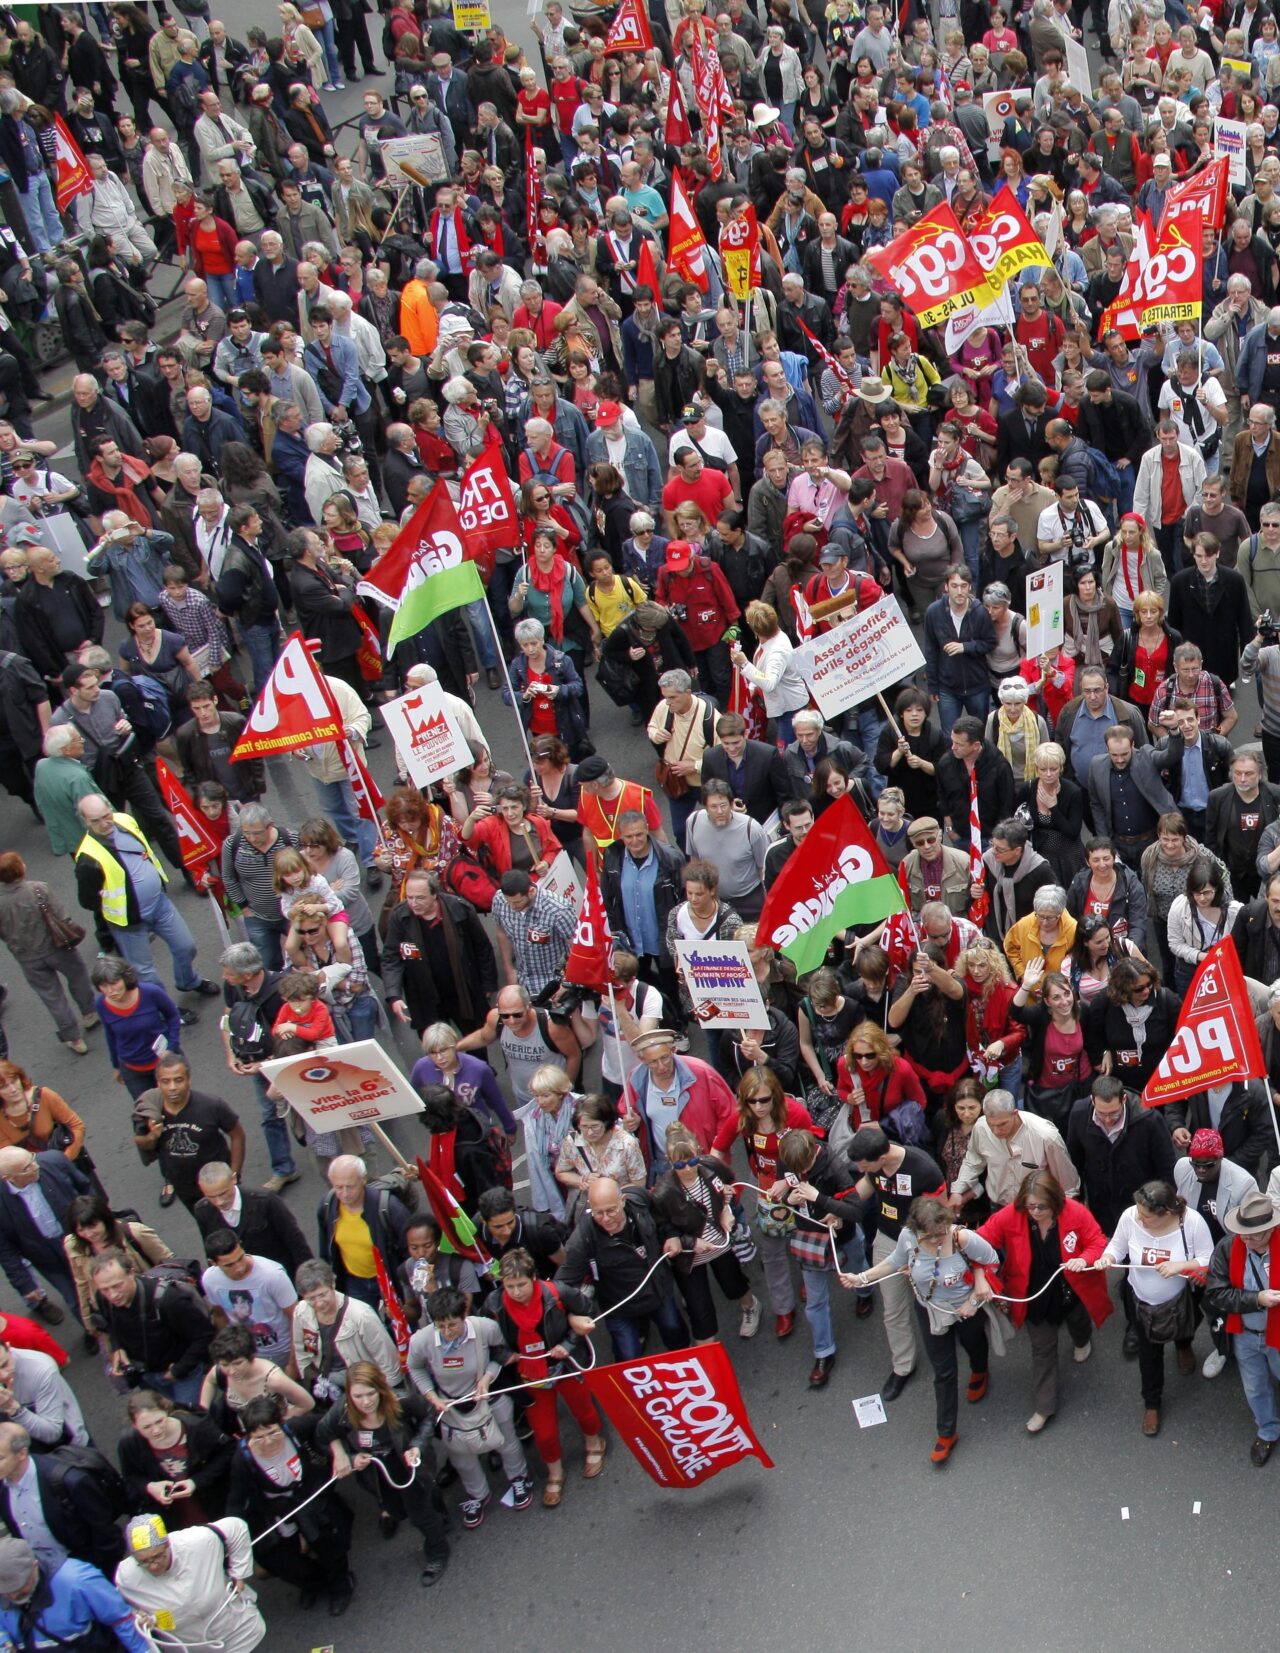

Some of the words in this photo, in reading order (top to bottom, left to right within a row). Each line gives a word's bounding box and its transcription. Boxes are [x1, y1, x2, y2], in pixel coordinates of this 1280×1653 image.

[1032, 577, 1039, 588] 6
[702, 612, 710, 622] 6
[813, 639, 848, 667] Assez
[848, 608, 888, 643] profité
[812, 657, 844, 682] qu'ils
[845, 615, 900, 660] dégagent
[845, 653, 873, 674] tous
[820, 688, 834, 699] VIVE
[834, 684, 844, 693] LES
[863, 659, 890, 676] PUBLIQUES
[898, 642, 913, 656] L'EAU
[416, 722, 448, 743] PRENEZ
[412, 748, 421, 756] LE
[422, 733, 450, 750] POUVOIR
[1246, 814, 1254, 827] 6
[393, 854, 401, 867] 6
[927, 885, 936, 897] 6
[1094, 902, 1102, 914] 6
[531, 930, 540, 942] 6
[403, 943, 412, 956] 6
[696, 1006, 710, 1018] 6
[501, 1042, 546, 1055] AMERICAN
[504, 1052, 542, 1063] COLLEGE
[1120, 1050, 1130, 1064] 6
[1056, 1059, 1066, 1071] 6
[346, 1088, 360, 1097] la
[310, 1088, 389, 1115] République
[758, 1154, 765, 1168] 6
[1210, 1202, 1217, 1216] 6
[1148, 1248, 1157, 1264] 6
[944, 1276, 961, 1288] PCF
[653, 1357, 754, 1459] FRONT
[622, 1366, 651, 1398] DE
[644, 1395, 713, 1480] GAUCHE
